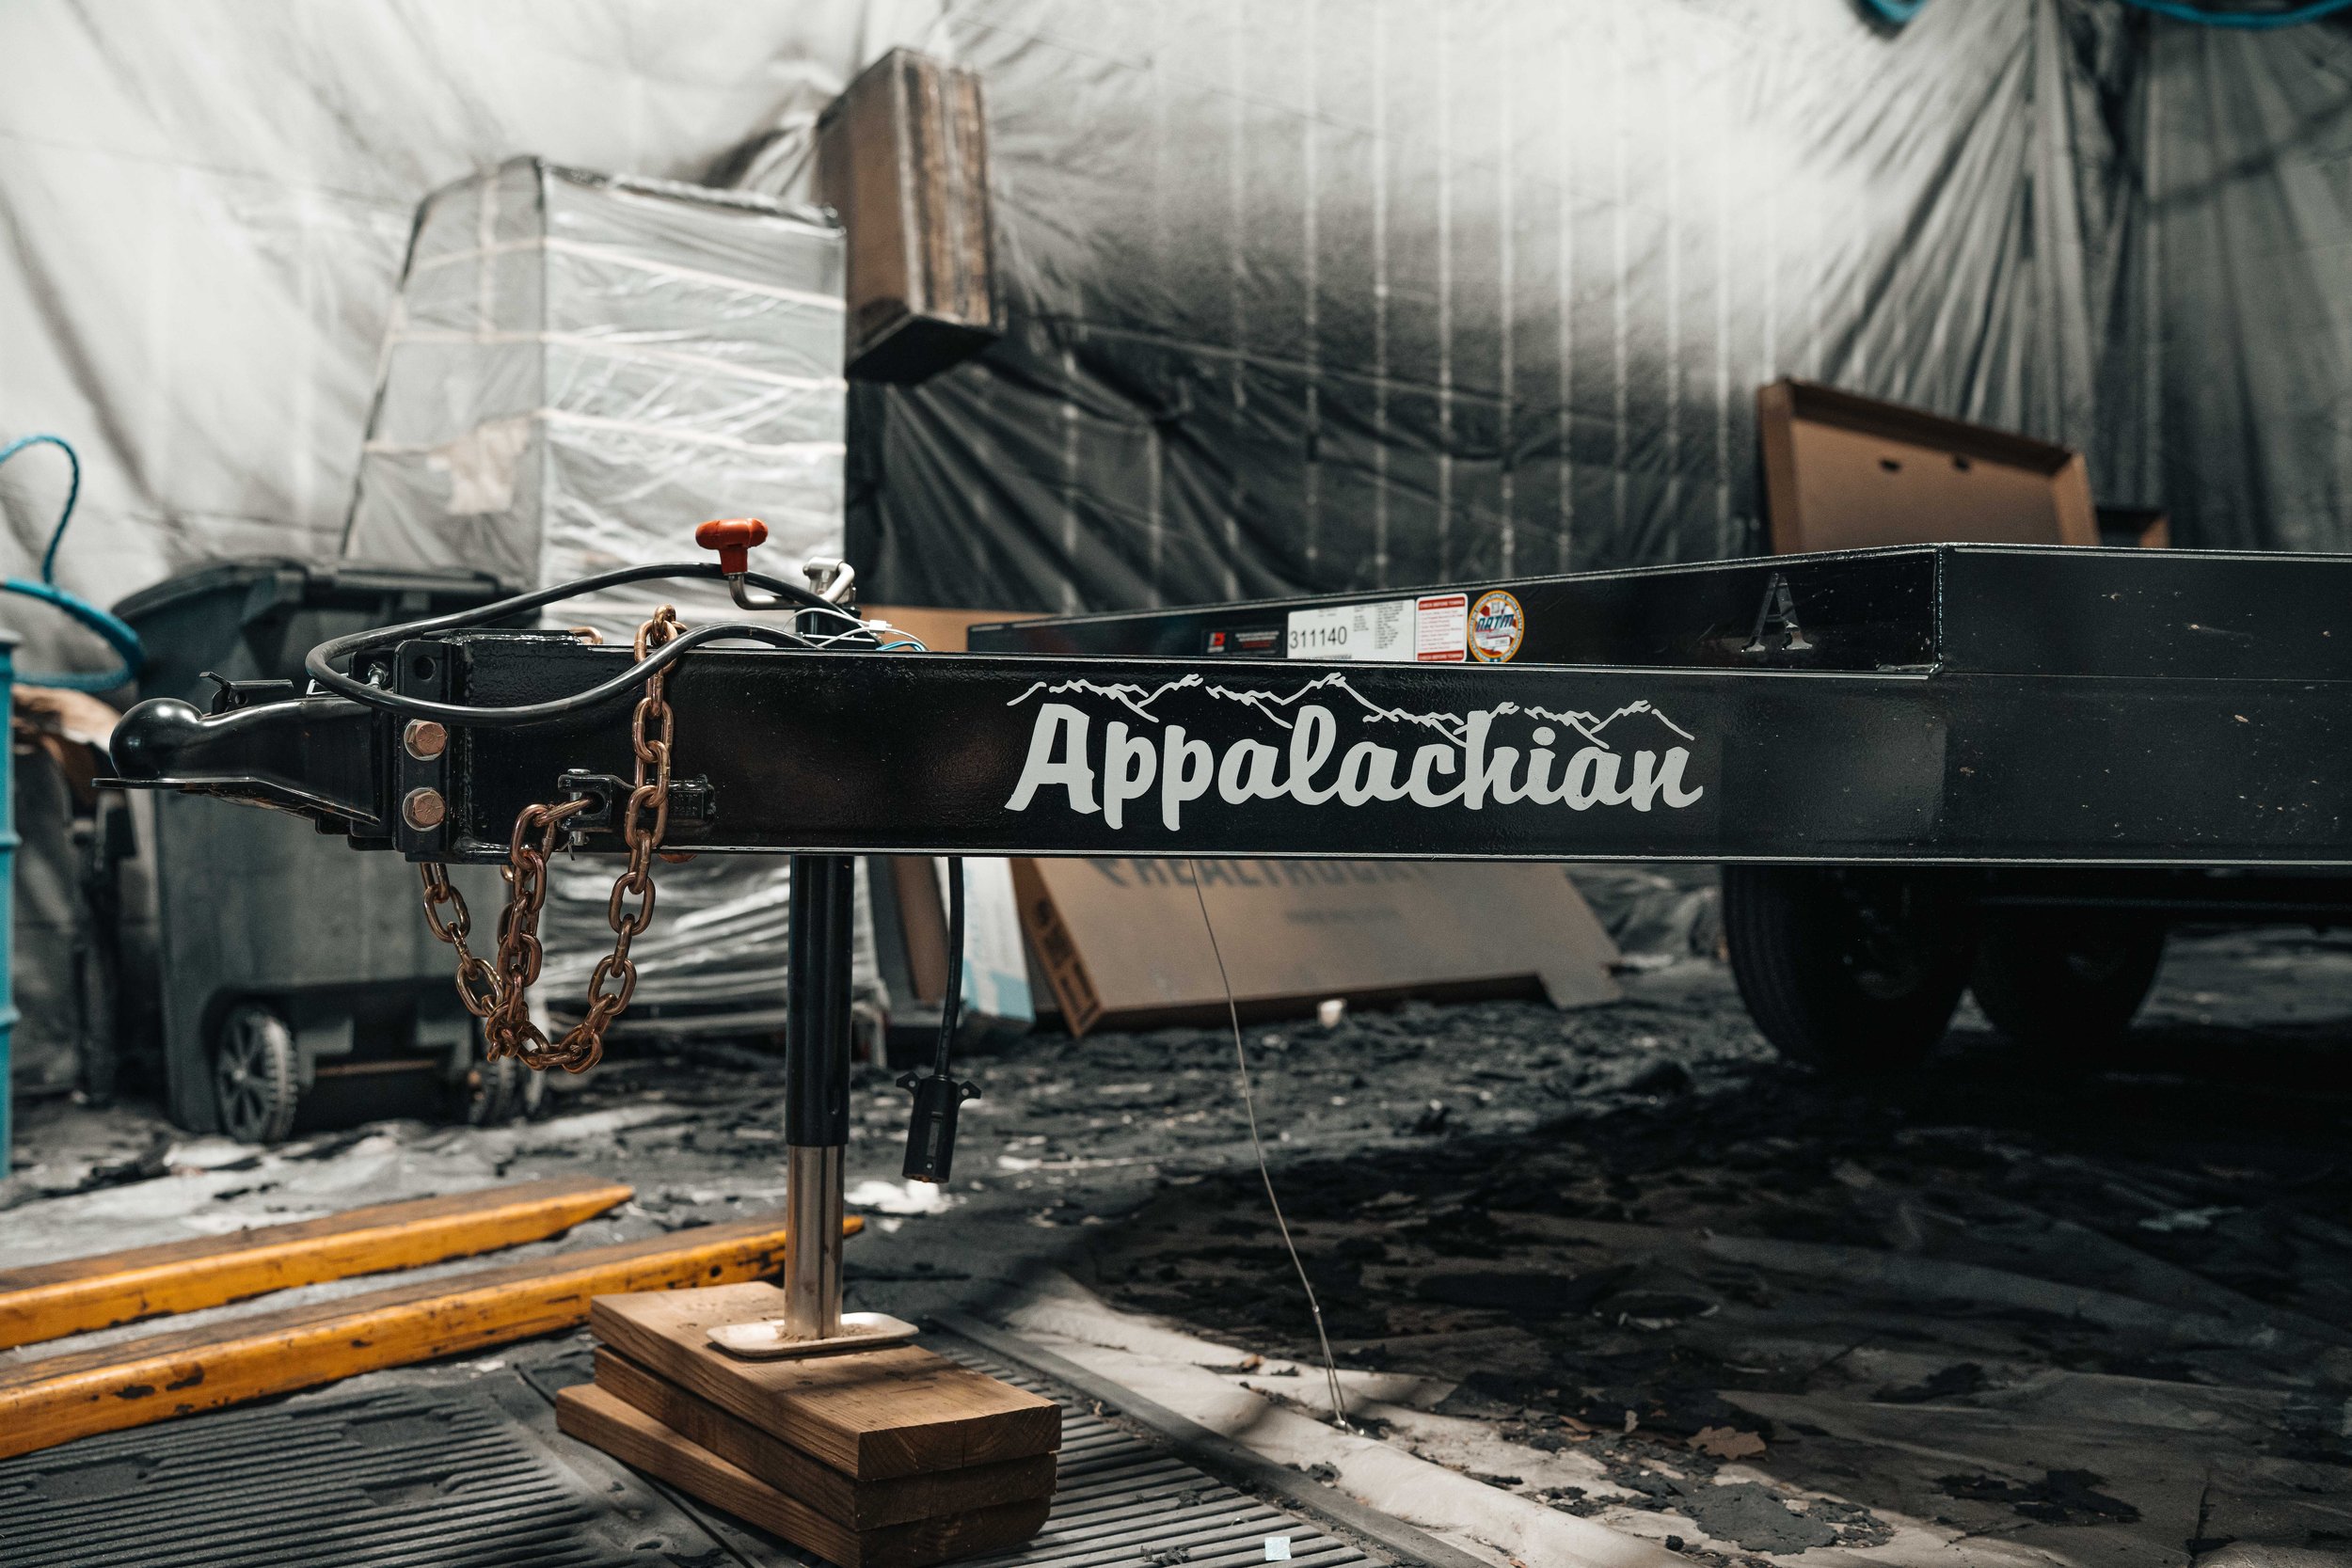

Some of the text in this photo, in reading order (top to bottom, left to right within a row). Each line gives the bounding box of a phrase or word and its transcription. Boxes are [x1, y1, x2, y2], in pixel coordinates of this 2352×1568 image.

[1289, 626, 1347, 649] 311140
[1740, 572, 1813, 653] A
[1004, 704, 1704, 832] Appalachian
